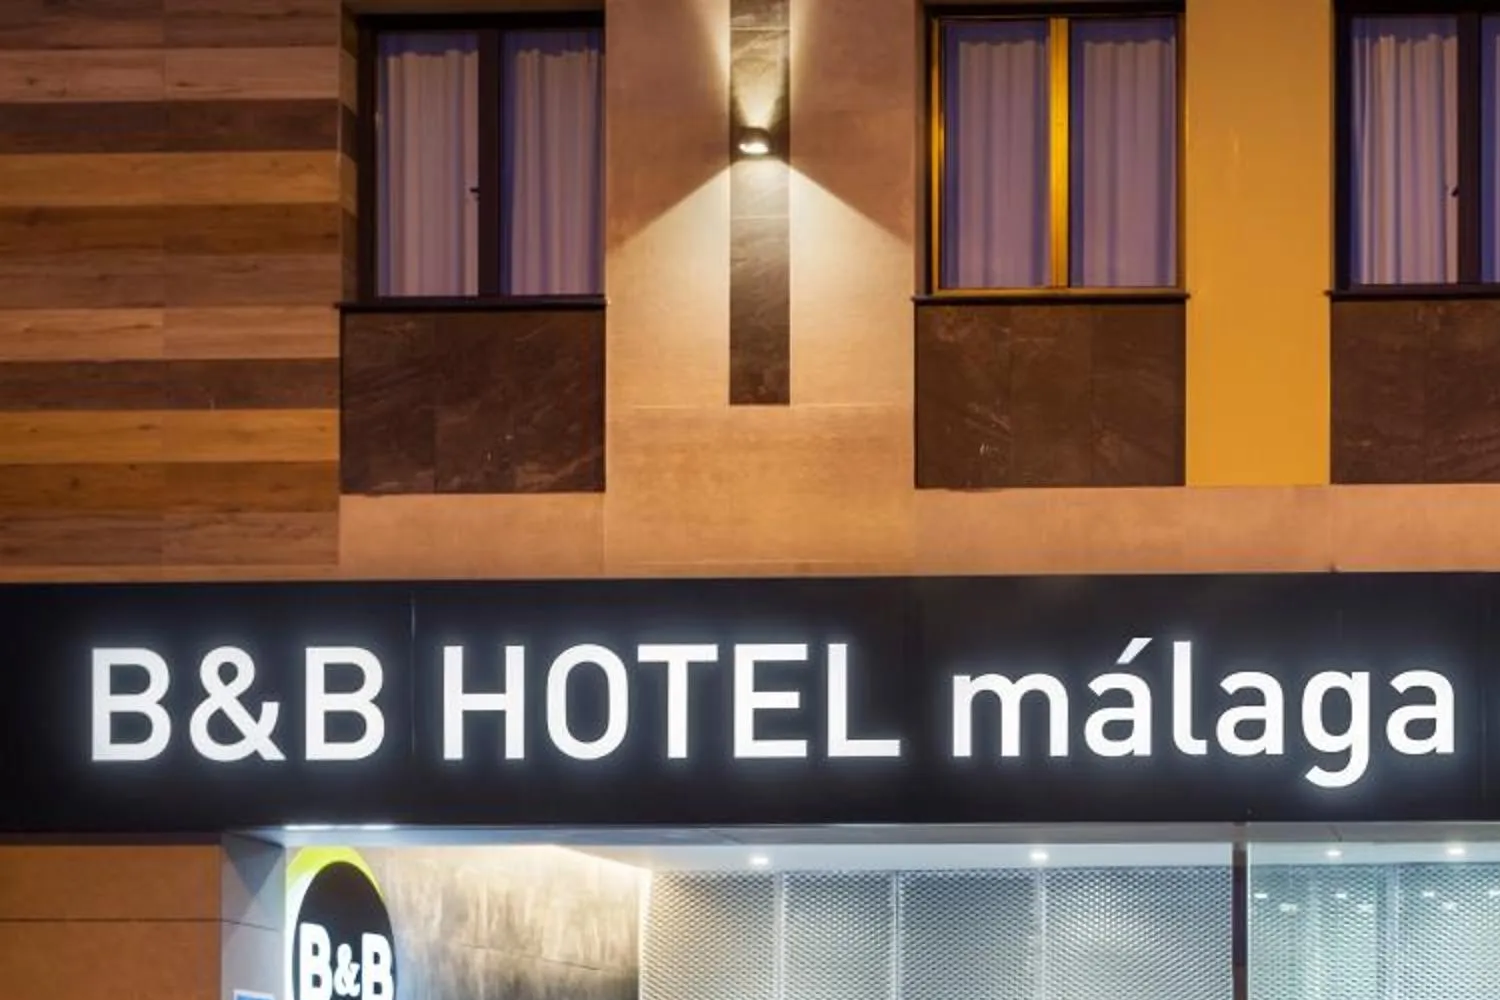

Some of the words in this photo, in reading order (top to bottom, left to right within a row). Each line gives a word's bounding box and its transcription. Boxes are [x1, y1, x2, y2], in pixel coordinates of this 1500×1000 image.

[92, 645, 386, 762] B&B
[442, 642, 901, 760] HOTEL
[952, 636, 1455, 789] málaga
